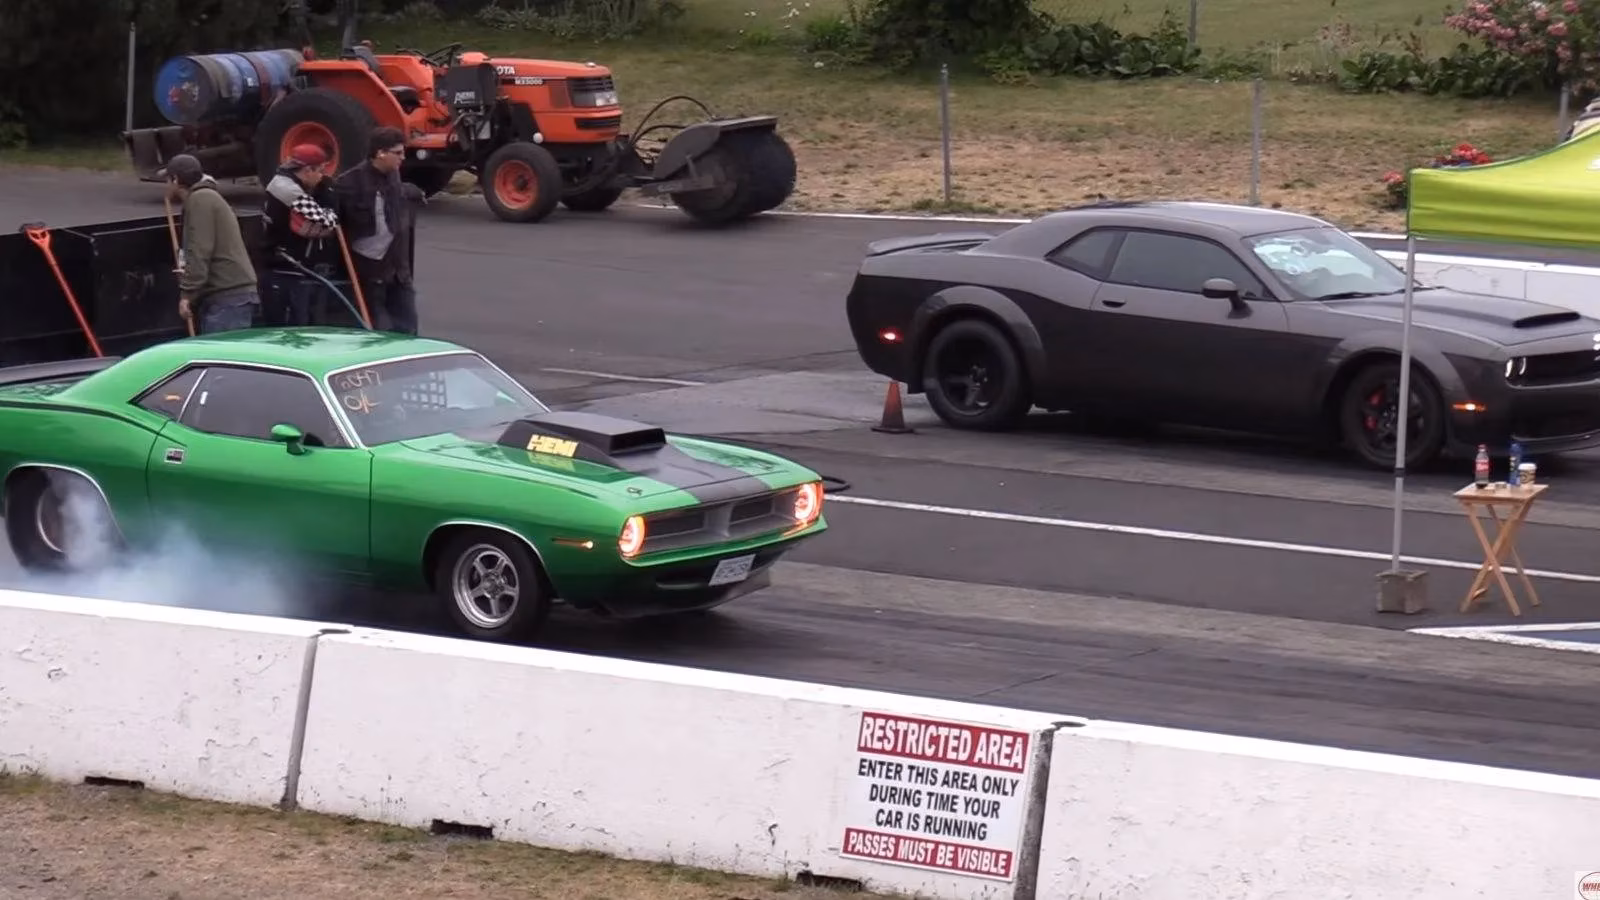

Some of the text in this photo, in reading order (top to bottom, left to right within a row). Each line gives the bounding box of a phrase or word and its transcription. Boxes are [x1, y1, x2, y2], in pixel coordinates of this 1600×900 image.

[526, 433, 580, 458] HEMI
[859, 716, 1024, 769] RESTRICTED AREA
[858, 758, 1019, 797] ENTER THIS AREA ONLY
[869, 783, 1001, 819] DURING TIME YOUR
[875, 808, 988, 841] CAR IS RUNNING
[847, 831, 1008, 875] PASSES MUST BE VISIBLE
